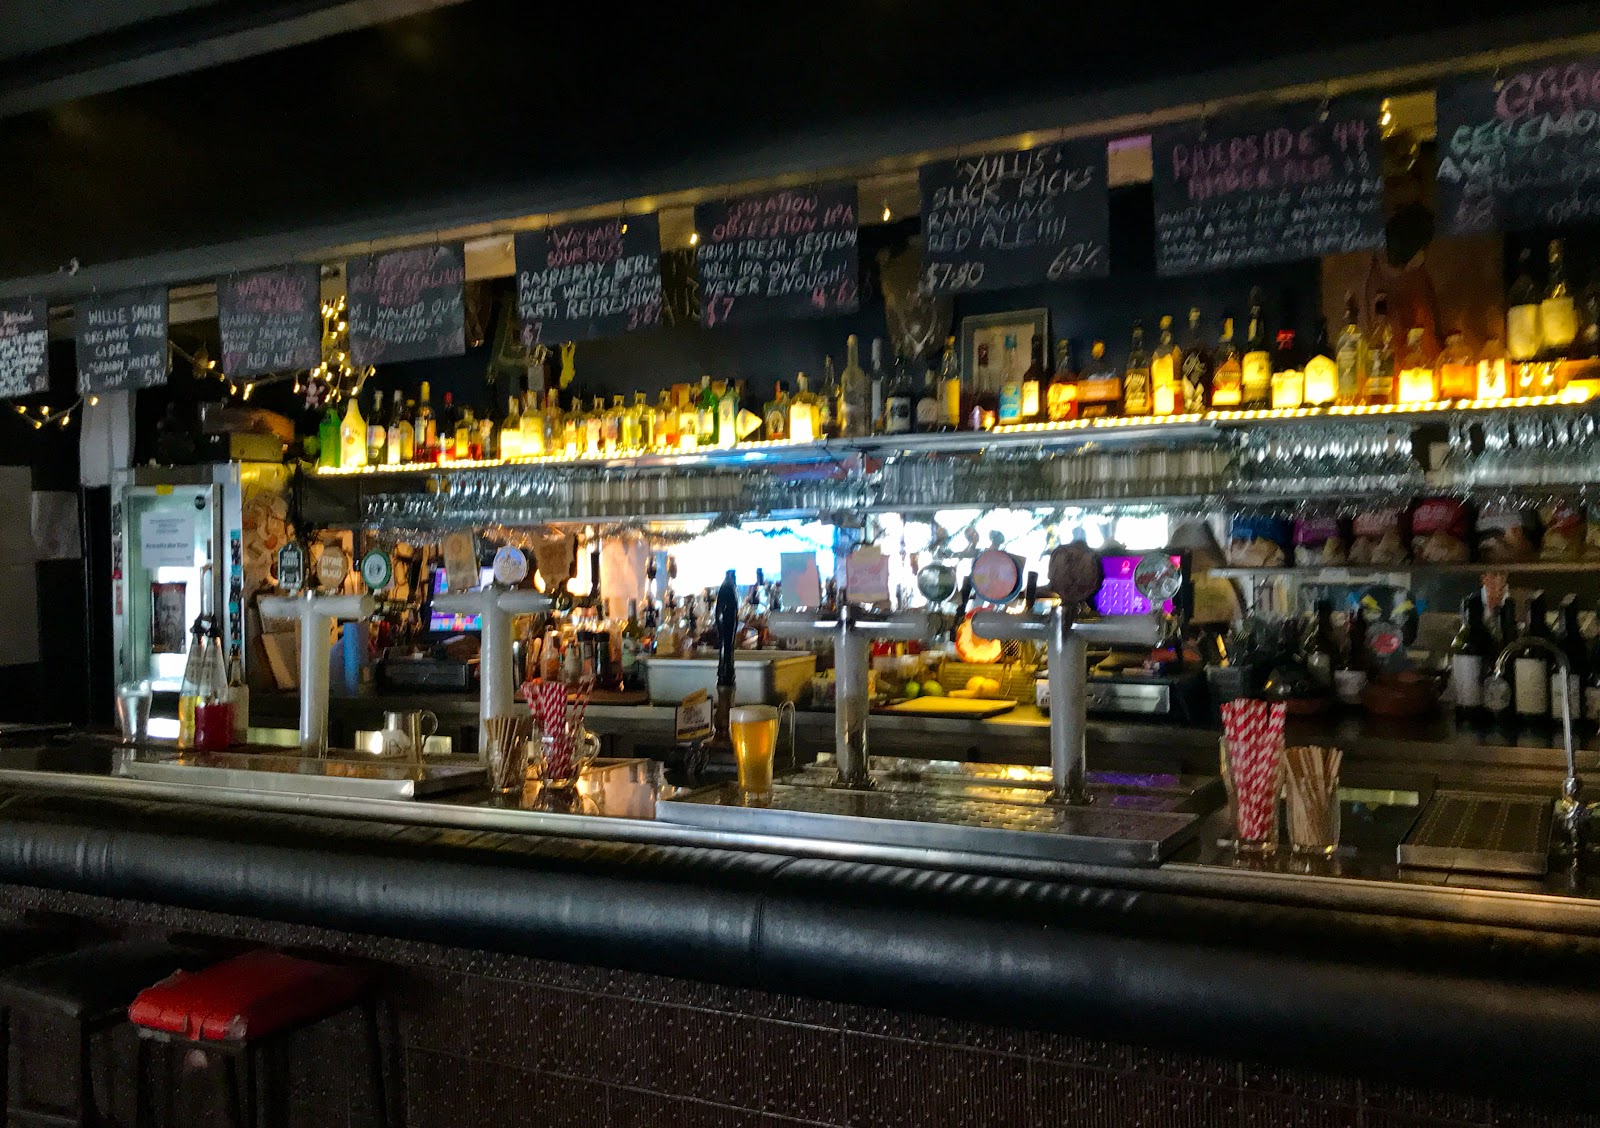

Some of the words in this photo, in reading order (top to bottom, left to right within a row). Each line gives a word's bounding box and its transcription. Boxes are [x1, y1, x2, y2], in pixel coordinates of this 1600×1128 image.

[711, 216, 817, 241] OBSESSION
[823, 203, 855, 229] IPA
[928, 200, 1056, 232] RAMPAGING
[794, 228, 858, 256] SESSION
[928, 229, 972, 251] RED
[769, 257, 804, 281] ONE
[810, 251, 824, 275] IS
[704, 277, 761, 298] NEVER
[88, 307, 127, 325] WILLIE
[131, 304, 161, 323] SMITH
[377, 301, 425, 320] WALKED
[84, 325, 129, 345] ORGANIC
[134, 323, 164, 339] APPLE
[95, 342, 131, 357] CIDER
[246, 351, 269, 369] RED
[272, 350, 293, 368] ALE
